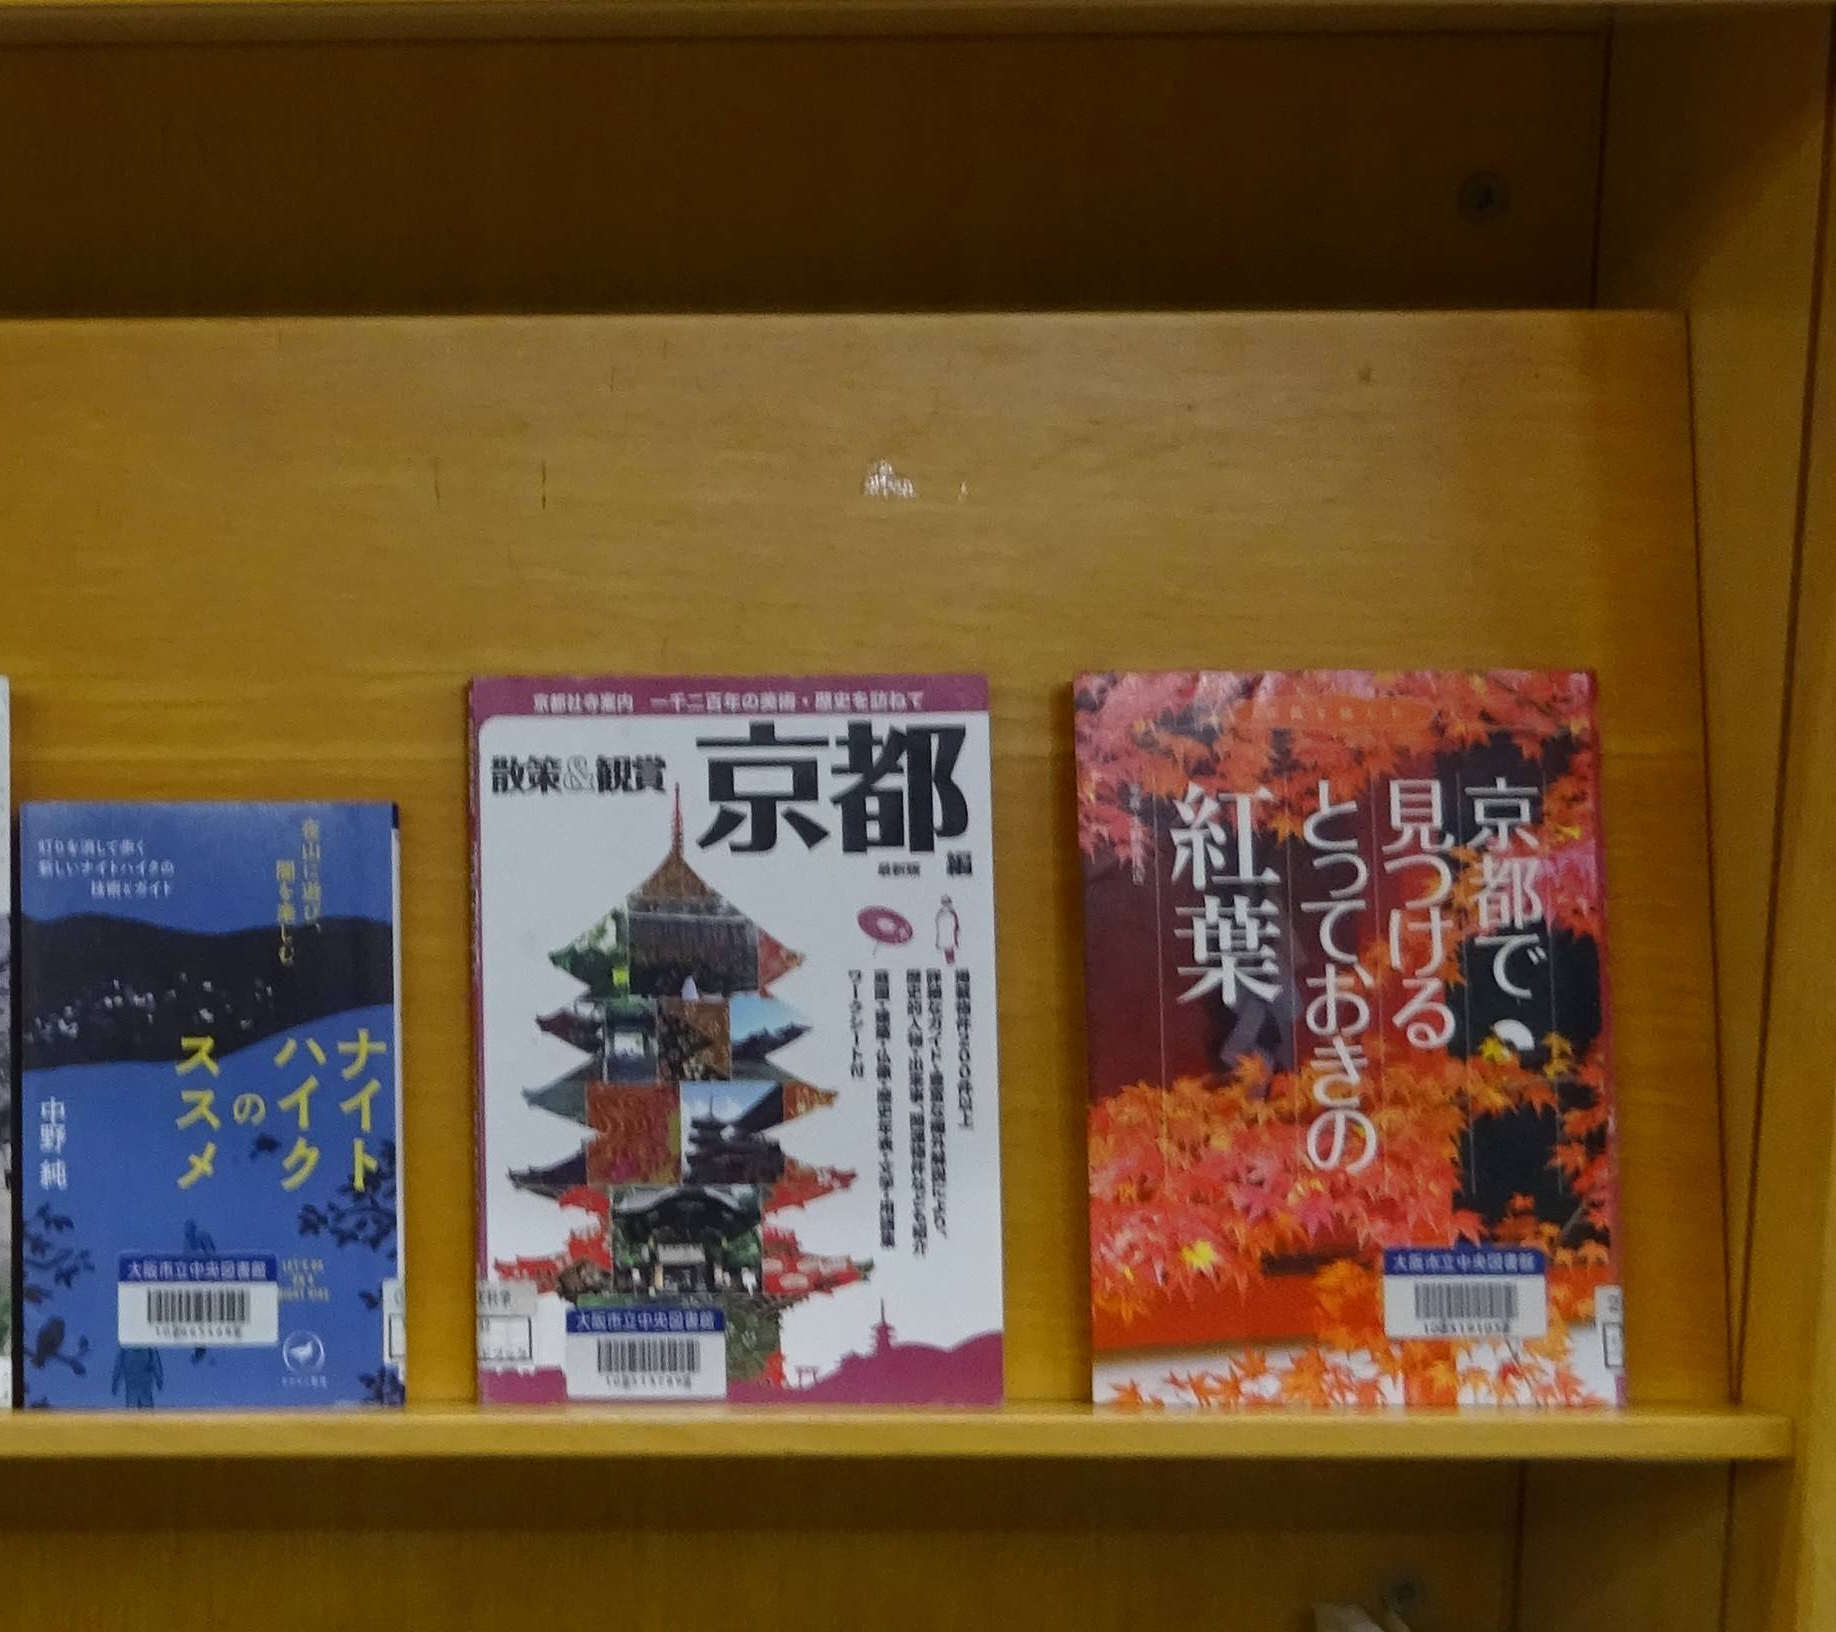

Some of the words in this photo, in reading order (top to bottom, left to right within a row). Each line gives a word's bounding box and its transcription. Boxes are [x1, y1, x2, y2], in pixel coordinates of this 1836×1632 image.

[694, 719, 969, 855] 京都
[1170, 781, 1283, 1007] 紅葉
[1383, 778, 1458, 1051] 見つける
[1301, 778, 1378, 1172] とっておきの
[175, 1034, 222, 1192] ススメ
[232, 1091, 267, 1126] の
[274, 1035, 327, 1192] ハイク
[337, 1027, 387, 1192] ナイト
